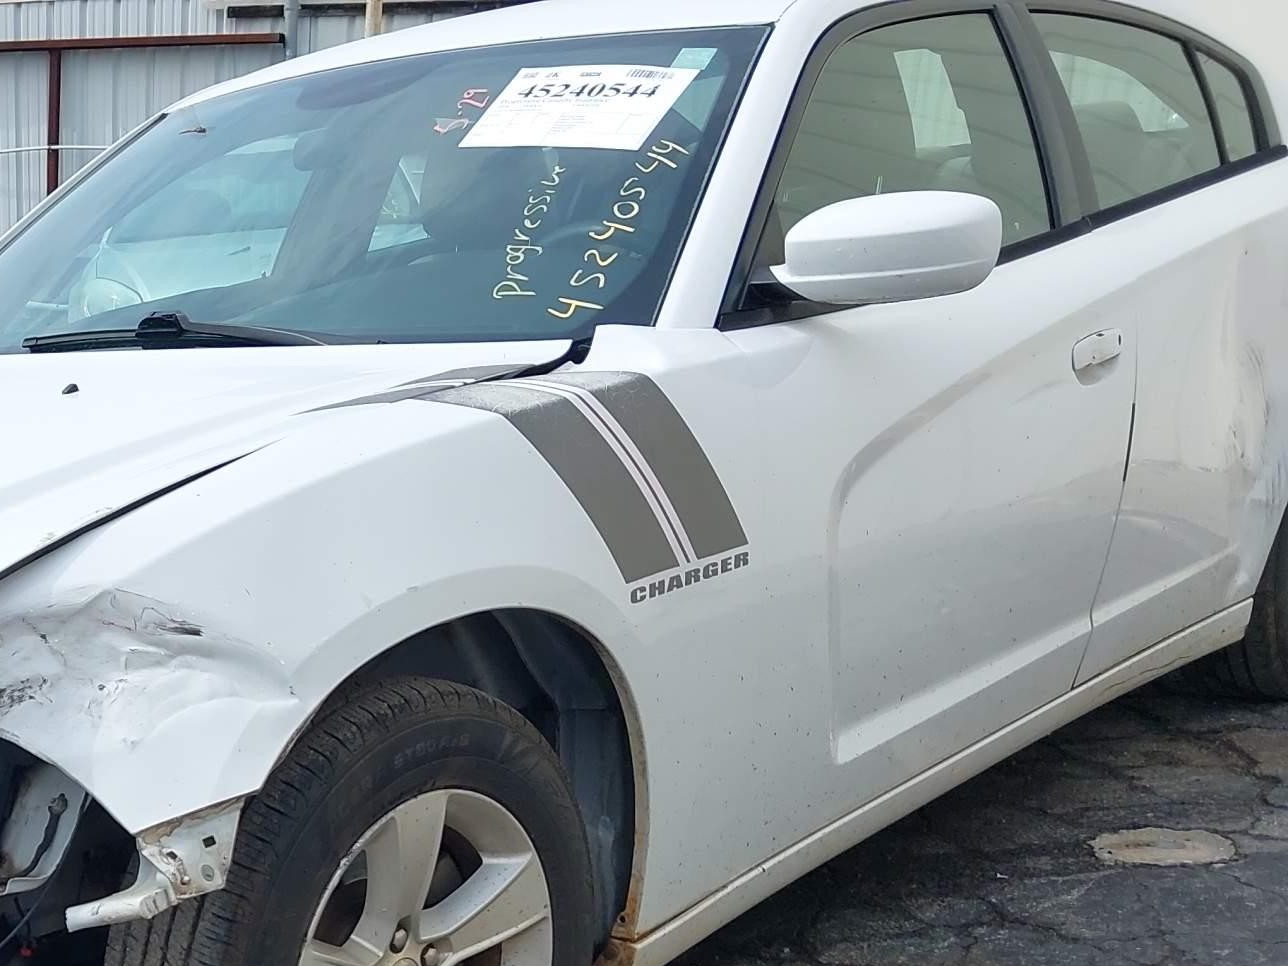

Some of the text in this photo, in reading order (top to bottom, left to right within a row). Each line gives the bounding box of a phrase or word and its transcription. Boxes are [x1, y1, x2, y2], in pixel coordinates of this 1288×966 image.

[518, 83, 661, 98] 45240544
[547, 139, 689, 318] 45240544
[630, 551, 749, 604] CHARGER
